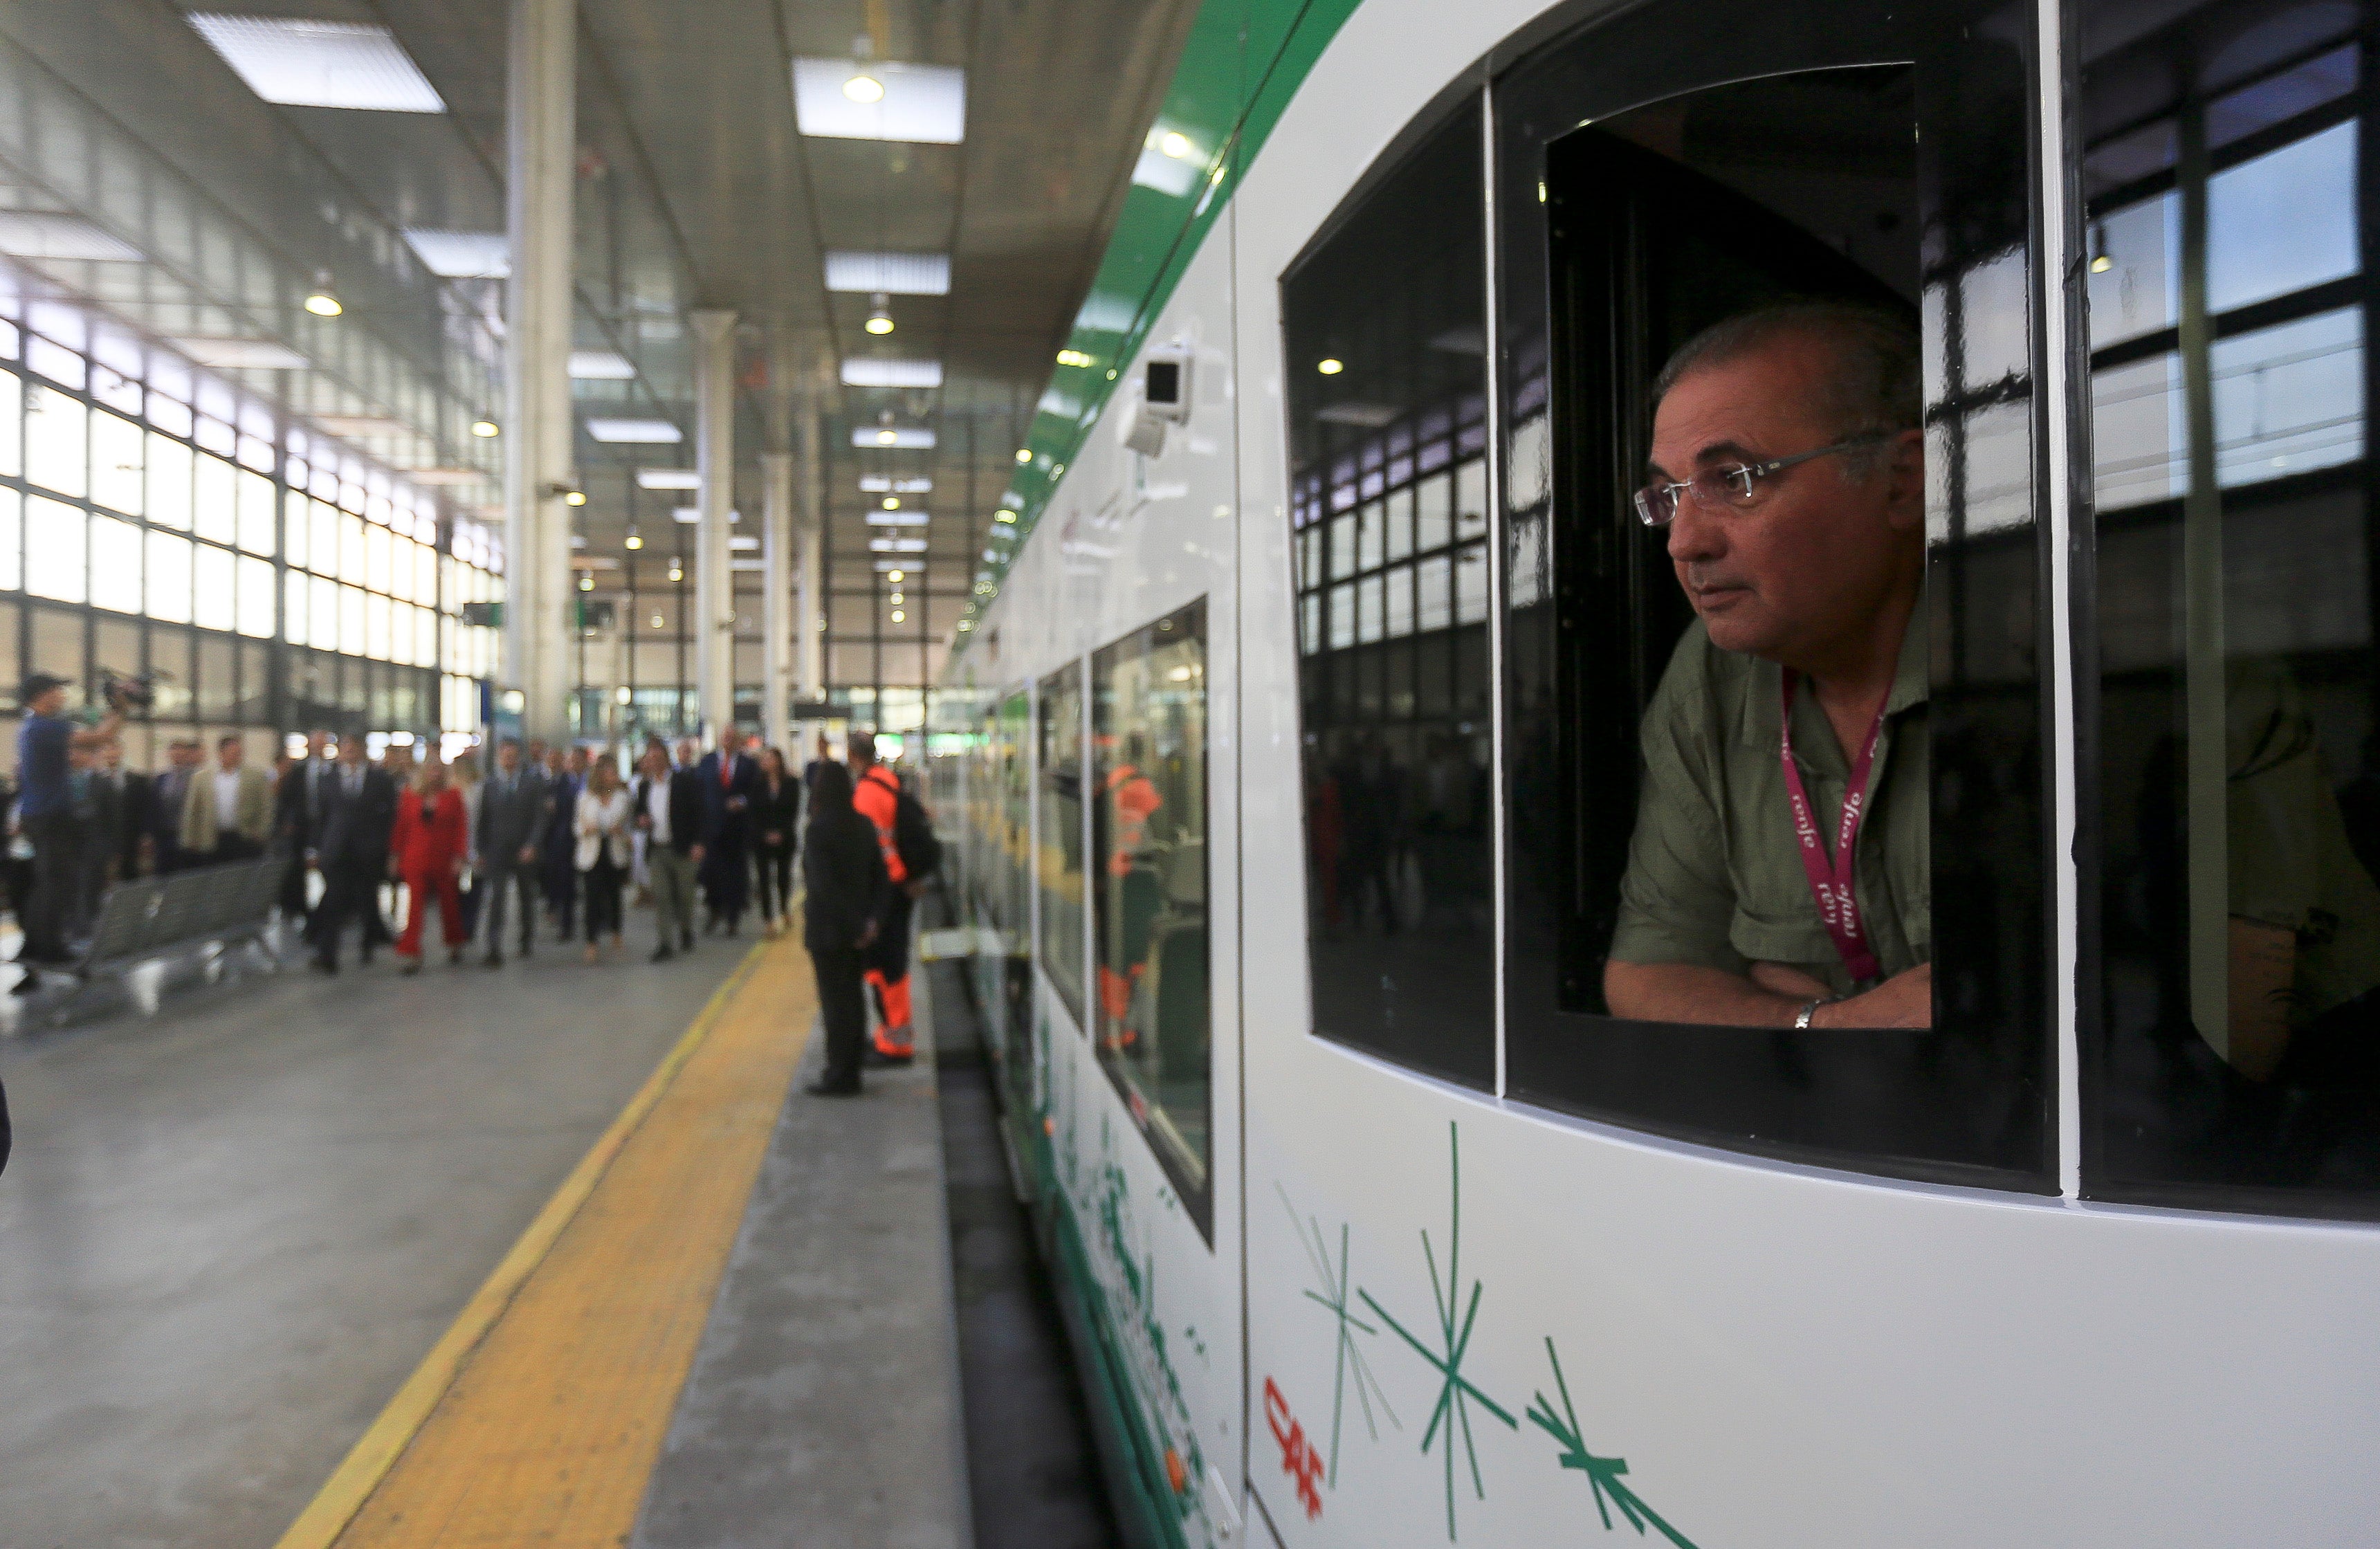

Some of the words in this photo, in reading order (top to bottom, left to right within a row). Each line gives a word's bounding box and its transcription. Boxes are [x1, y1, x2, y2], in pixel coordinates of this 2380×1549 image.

[1793, 794, 1816, 847] renfe
[1841, 793, 1862, 848] renfe
[1836, 883, 1857, 937] renfe
[1263, 1375, 1325, 1521] CAF
